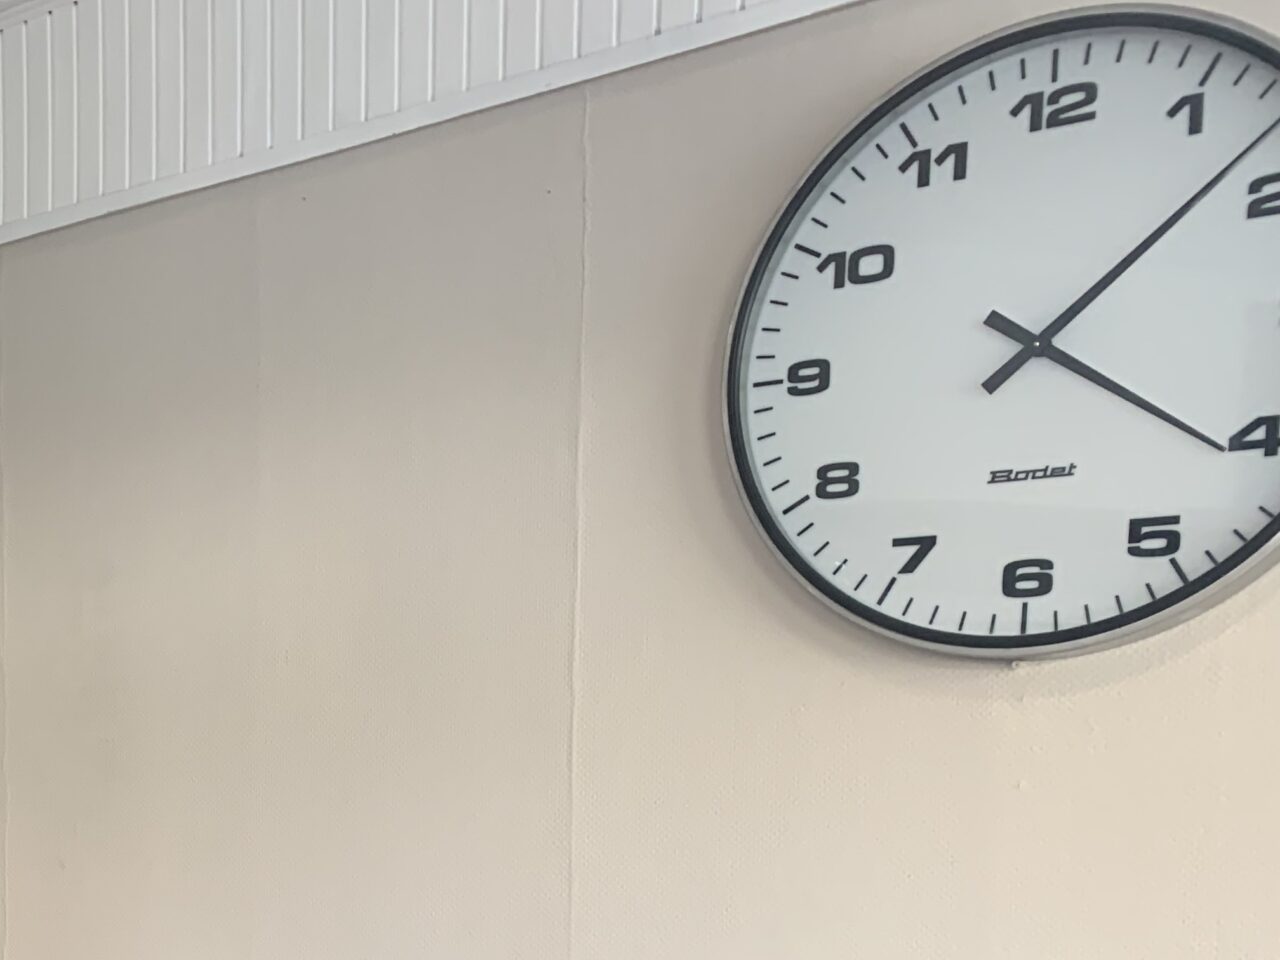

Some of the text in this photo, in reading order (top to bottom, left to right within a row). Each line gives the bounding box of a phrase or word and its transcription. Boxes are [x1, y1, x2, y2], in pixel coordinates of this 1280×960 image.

[1010, 82, 1098, 132] 12
[1167, 93, 1205, 135] 1
[899, 142, 969, 188] 11
[816, 245, 896, 289] 10
[787, 359, 831, 396] 9
[1228, 415, 1280, 457] 4
[815, 462, 860, 499] 8
[987, 462, 1078, 484] Bodet
[892, 535, 937, 574] 7
[1128, 515, 1181, 557] 5
[1002, 558, 1054, 598] 6
